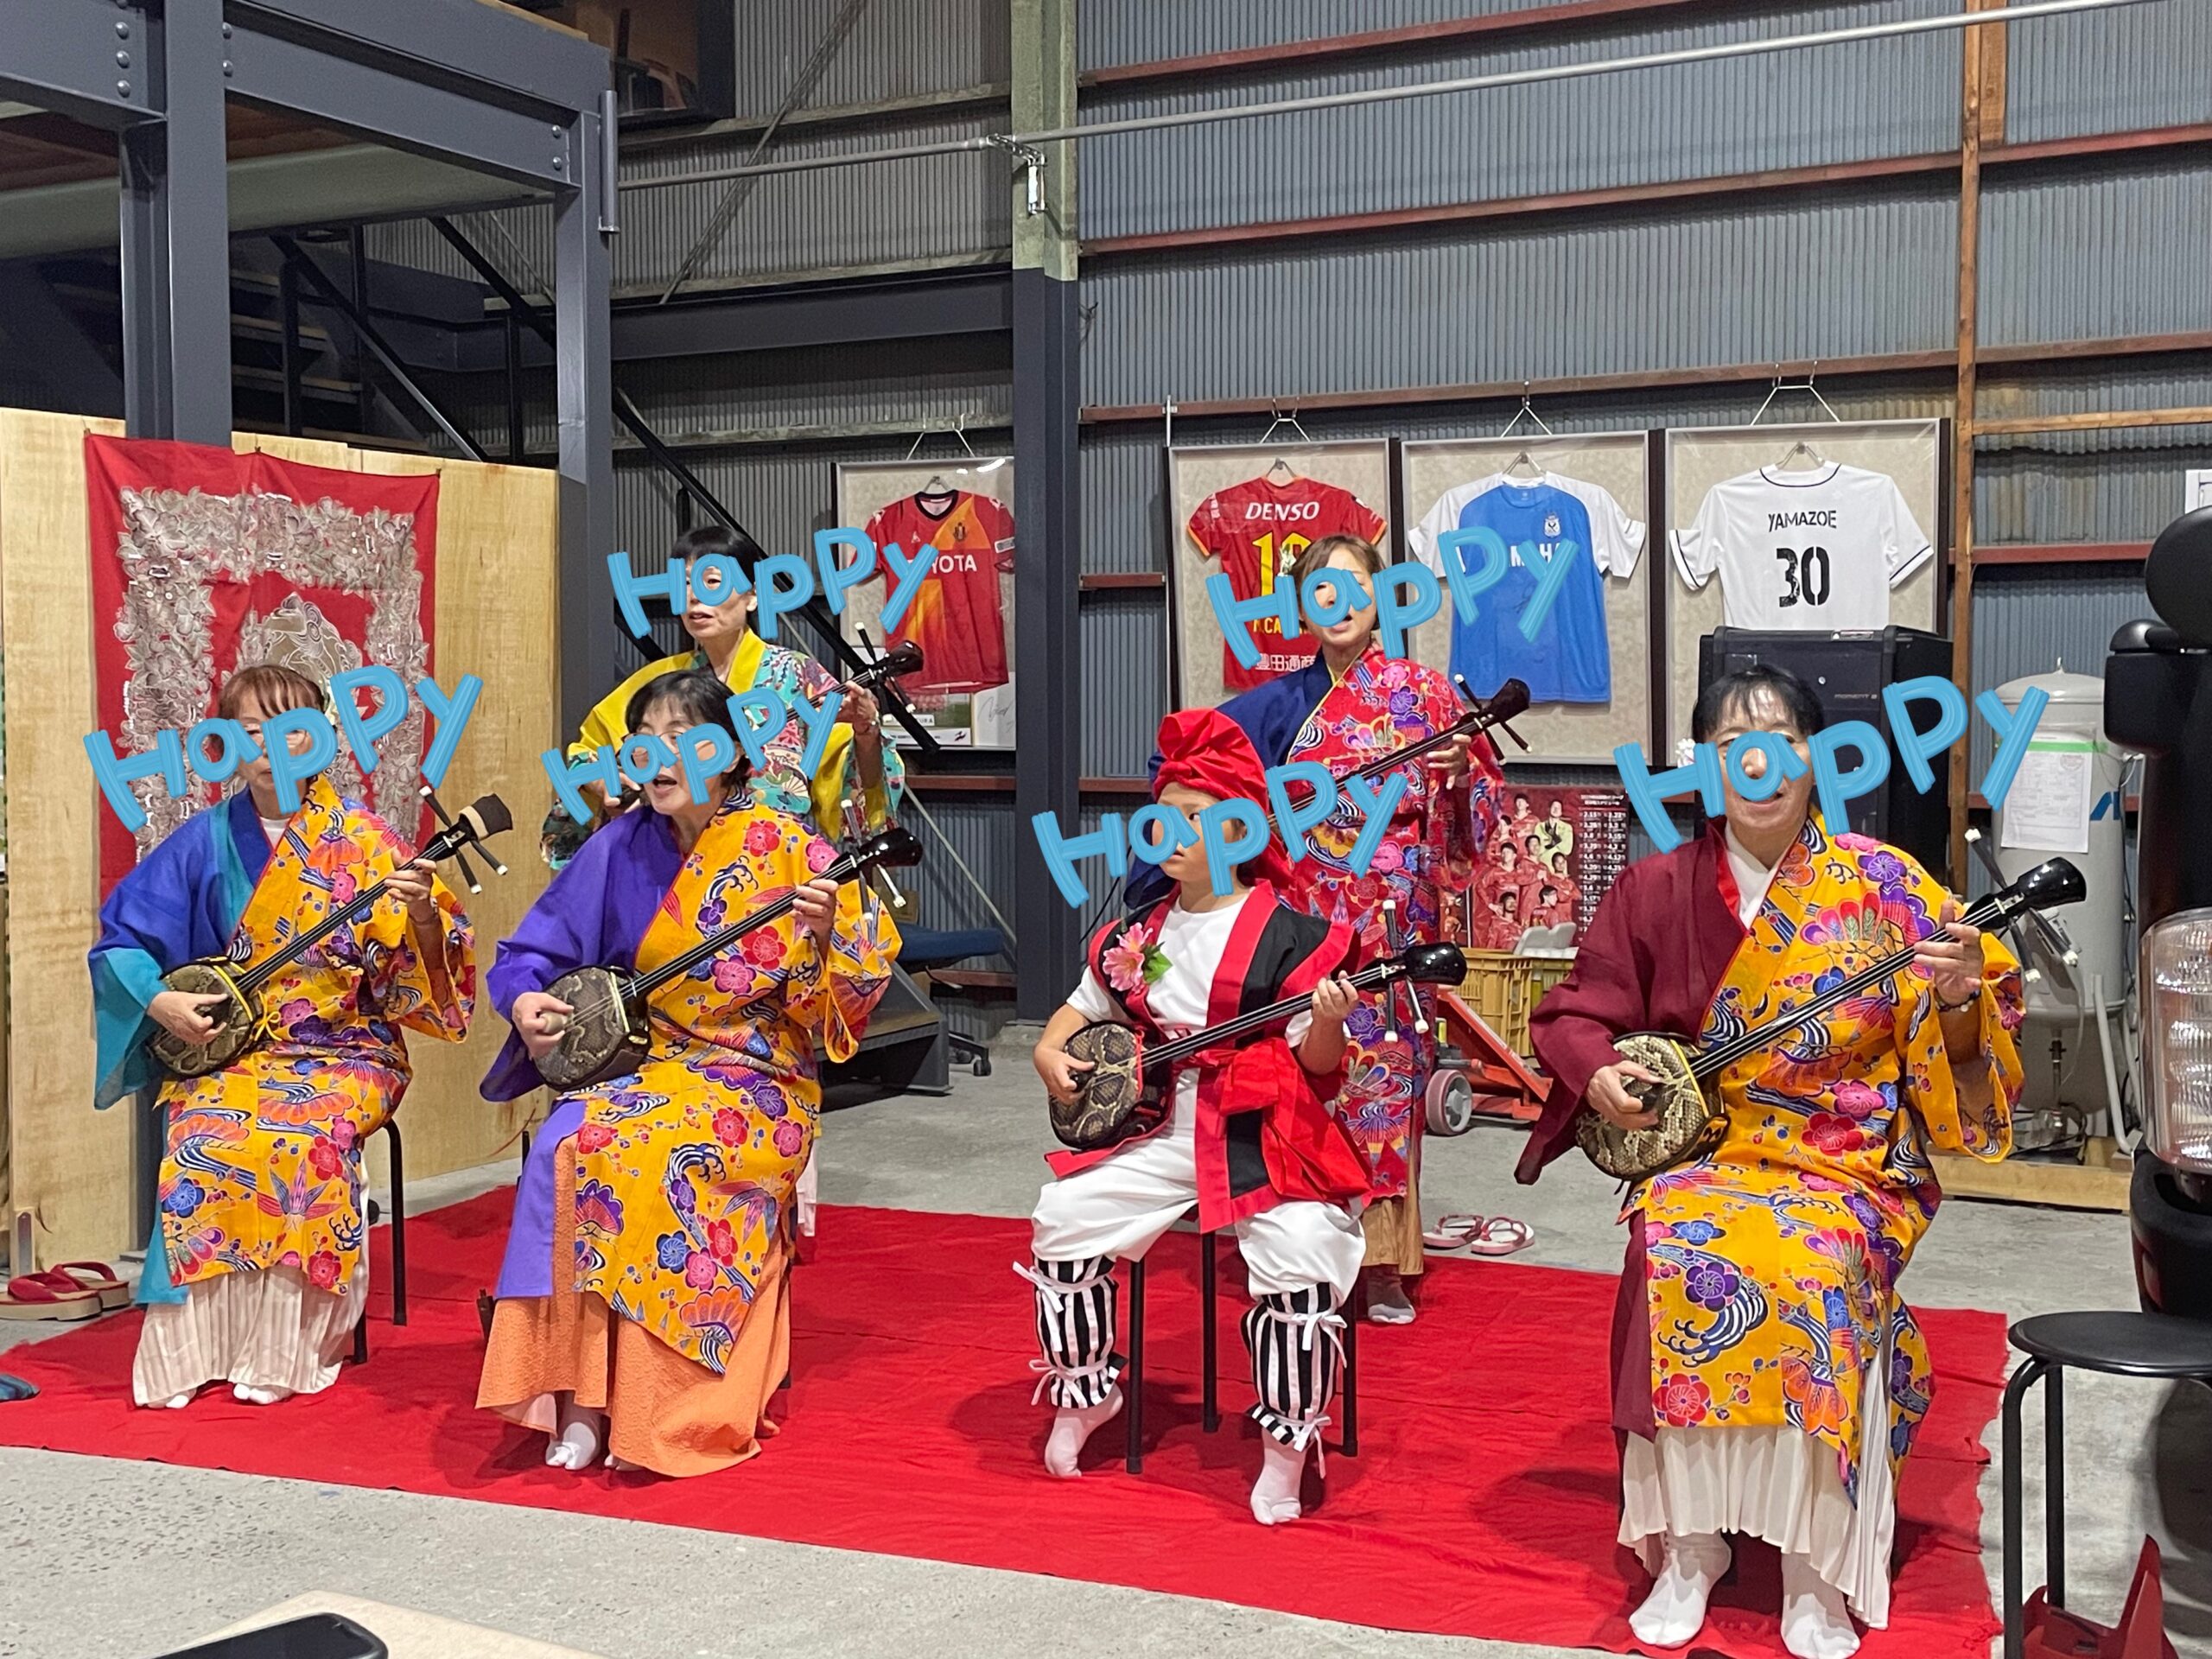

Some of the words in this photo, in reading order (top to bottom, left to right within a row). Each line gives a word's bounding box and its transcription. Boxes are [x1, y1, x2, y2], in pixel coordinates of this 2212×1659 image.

[1245, 501, 1320, 521] DENSO
[1768, 510, 1837, 532] YAMAZOE
[1776, 546, 1830, 607] 30
